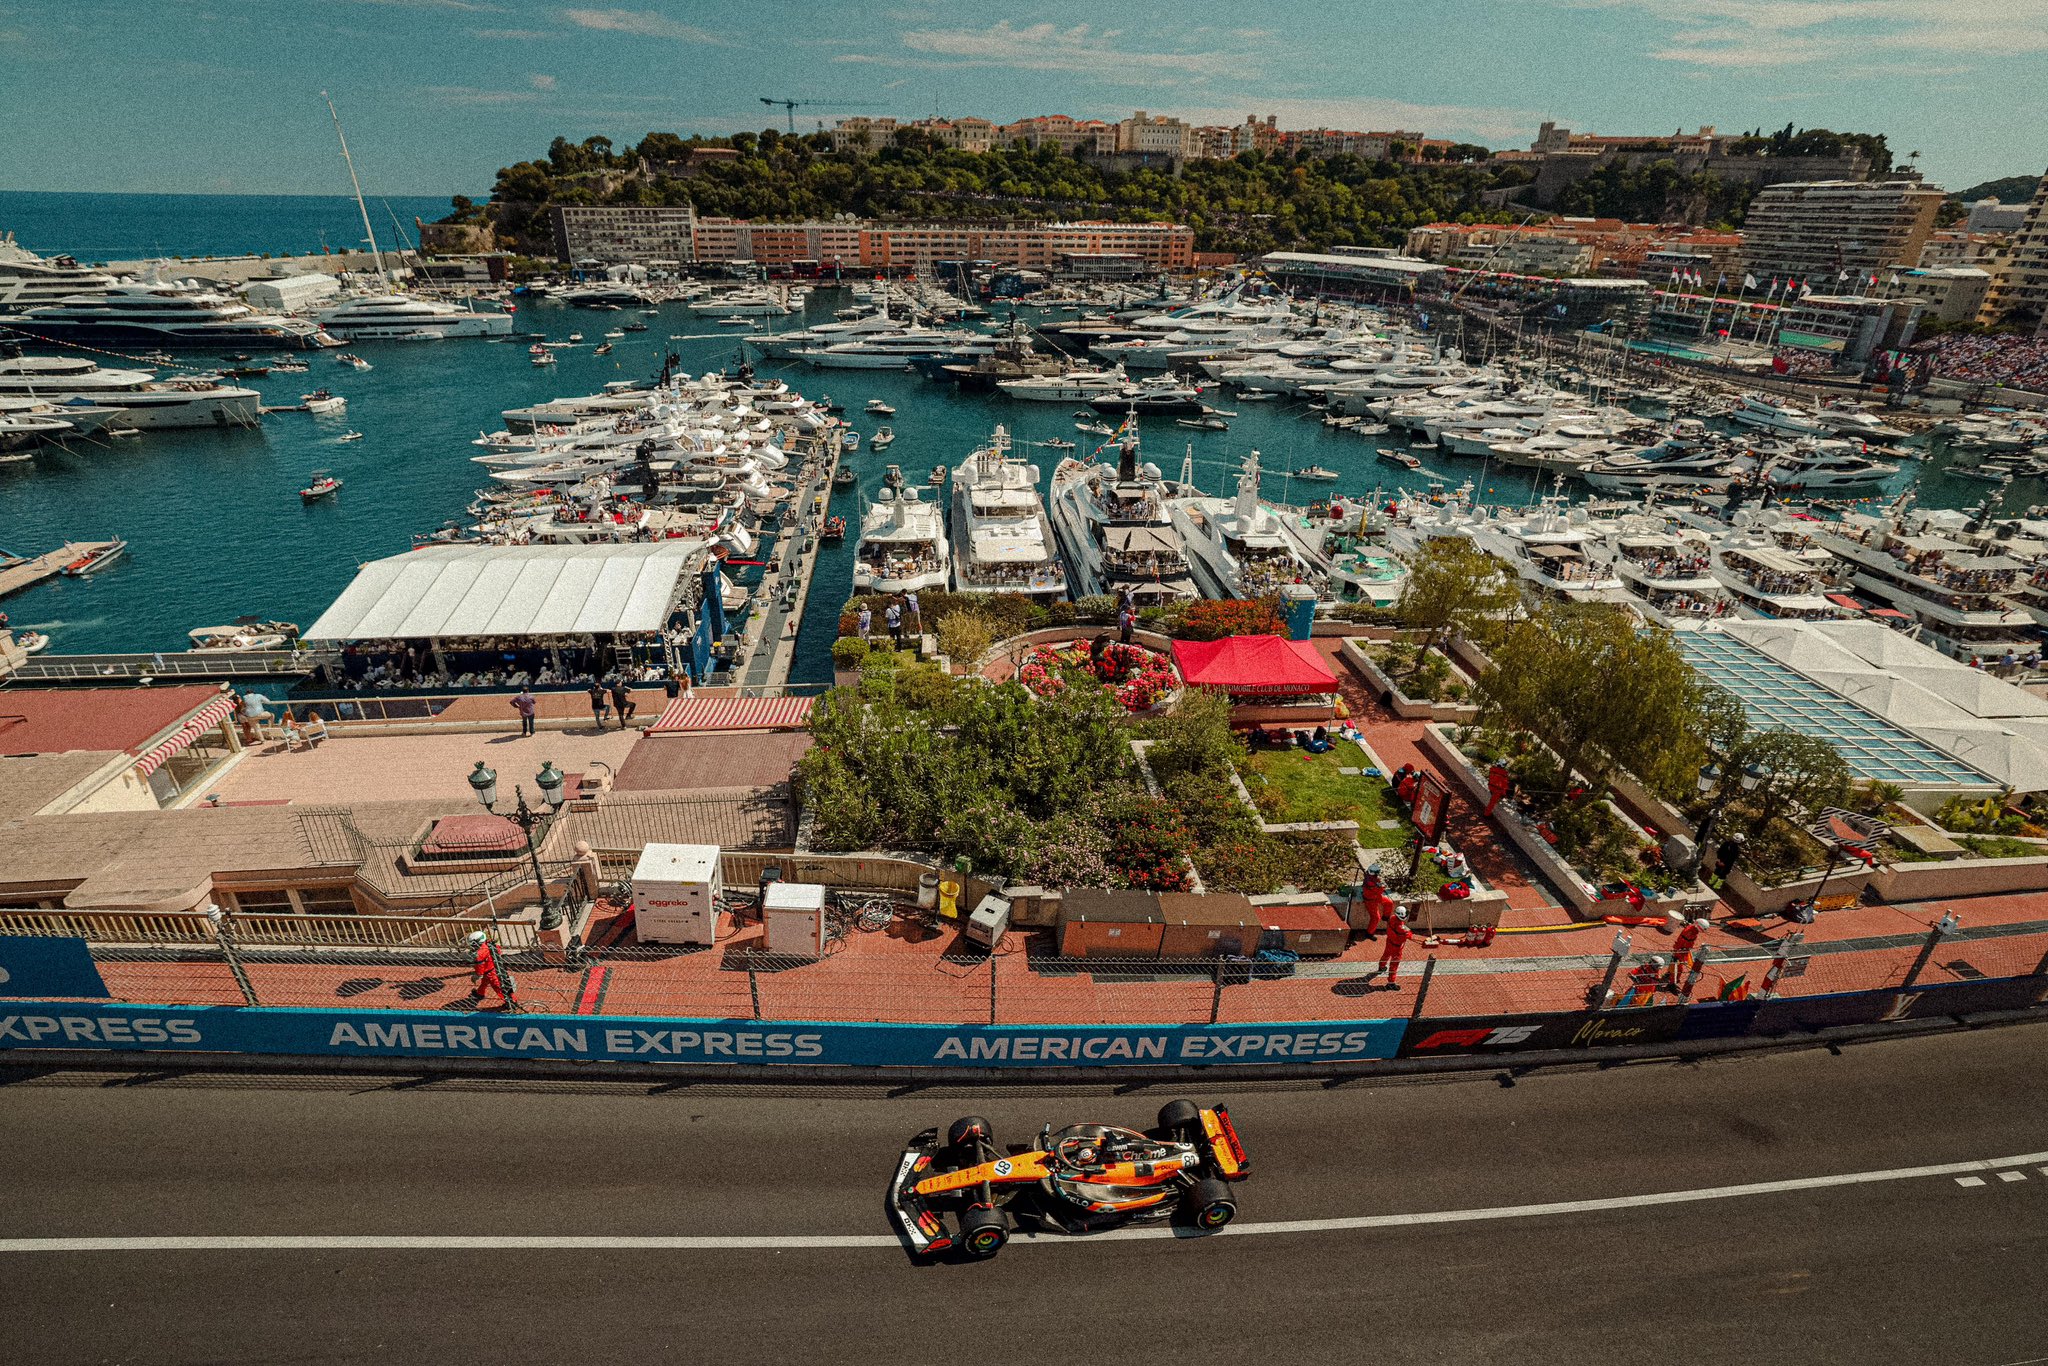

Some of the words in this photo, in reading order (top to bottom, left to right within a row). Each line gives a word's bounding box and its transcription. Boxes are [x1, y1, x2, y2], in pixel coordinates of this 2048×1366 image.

[1256, 684, 1273, 693] CLUB
[1273, 684, 1282, 692] DE
[1283, 684, 1310, 692] MONACO
[648, 899, 688, 907] aggreko
[329, 1023, 588, 1052] AMERICAN
[606, 1029, 823, 1057] EXPRESS
[1571, 1018, 1645, 1047] Monaco
[934, 1035, 1168, 1059] AMERICAN
[1180, 1031, 1368, 1058] EXPRESS
[1122, 1147, 1167, 1160] Chrome
[994, 1160, 1011, 1175] 81
